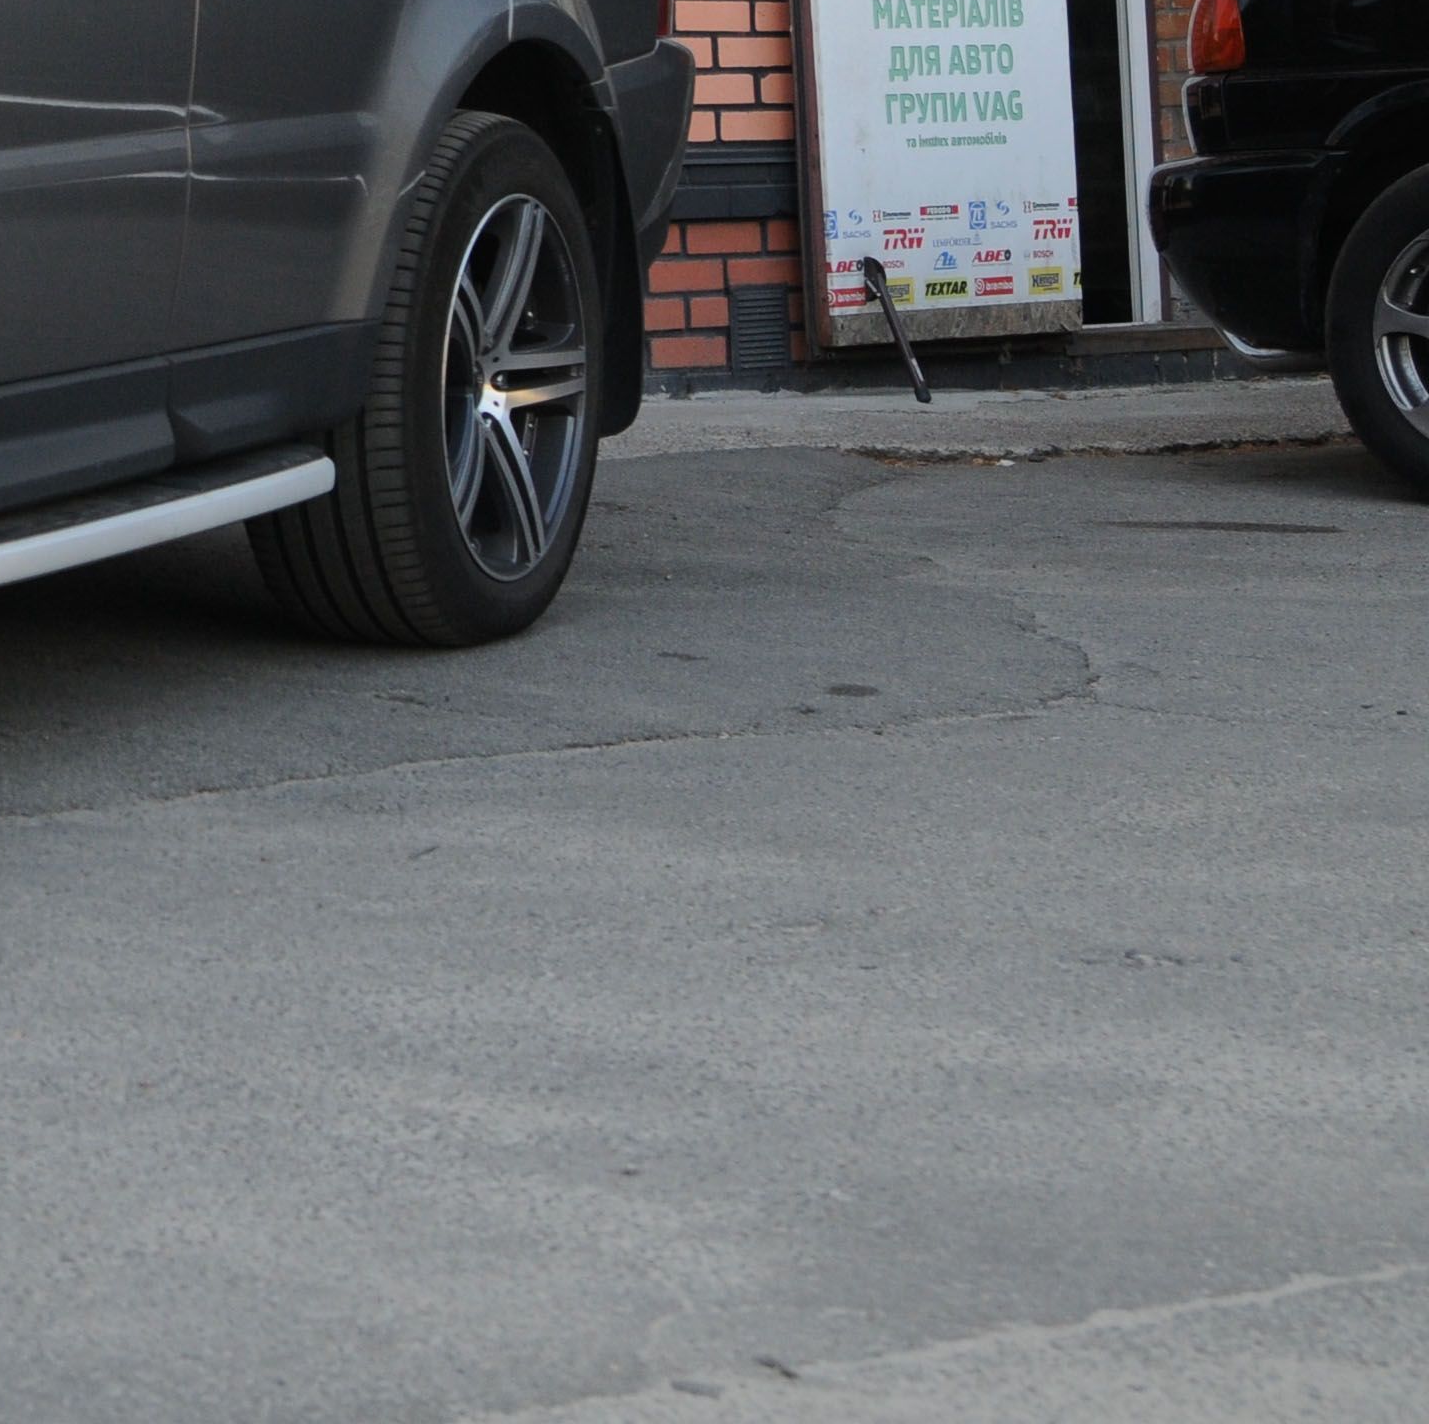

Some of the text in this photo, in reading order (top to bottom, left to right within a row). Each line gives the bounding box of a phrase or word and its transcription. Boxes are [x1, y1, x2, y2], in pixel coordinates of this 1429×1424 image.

[888, 43, 1014, 82] ДЛЯ АВТО
[884, 89, 1024, 125] ГРУПИ VAG
[905, 137, 917, 149] та
[882, 227, 926, 251] TRW
[1032, 218, 1073, 241] TRW
[924, 280, 968, 297] TEXTAR
